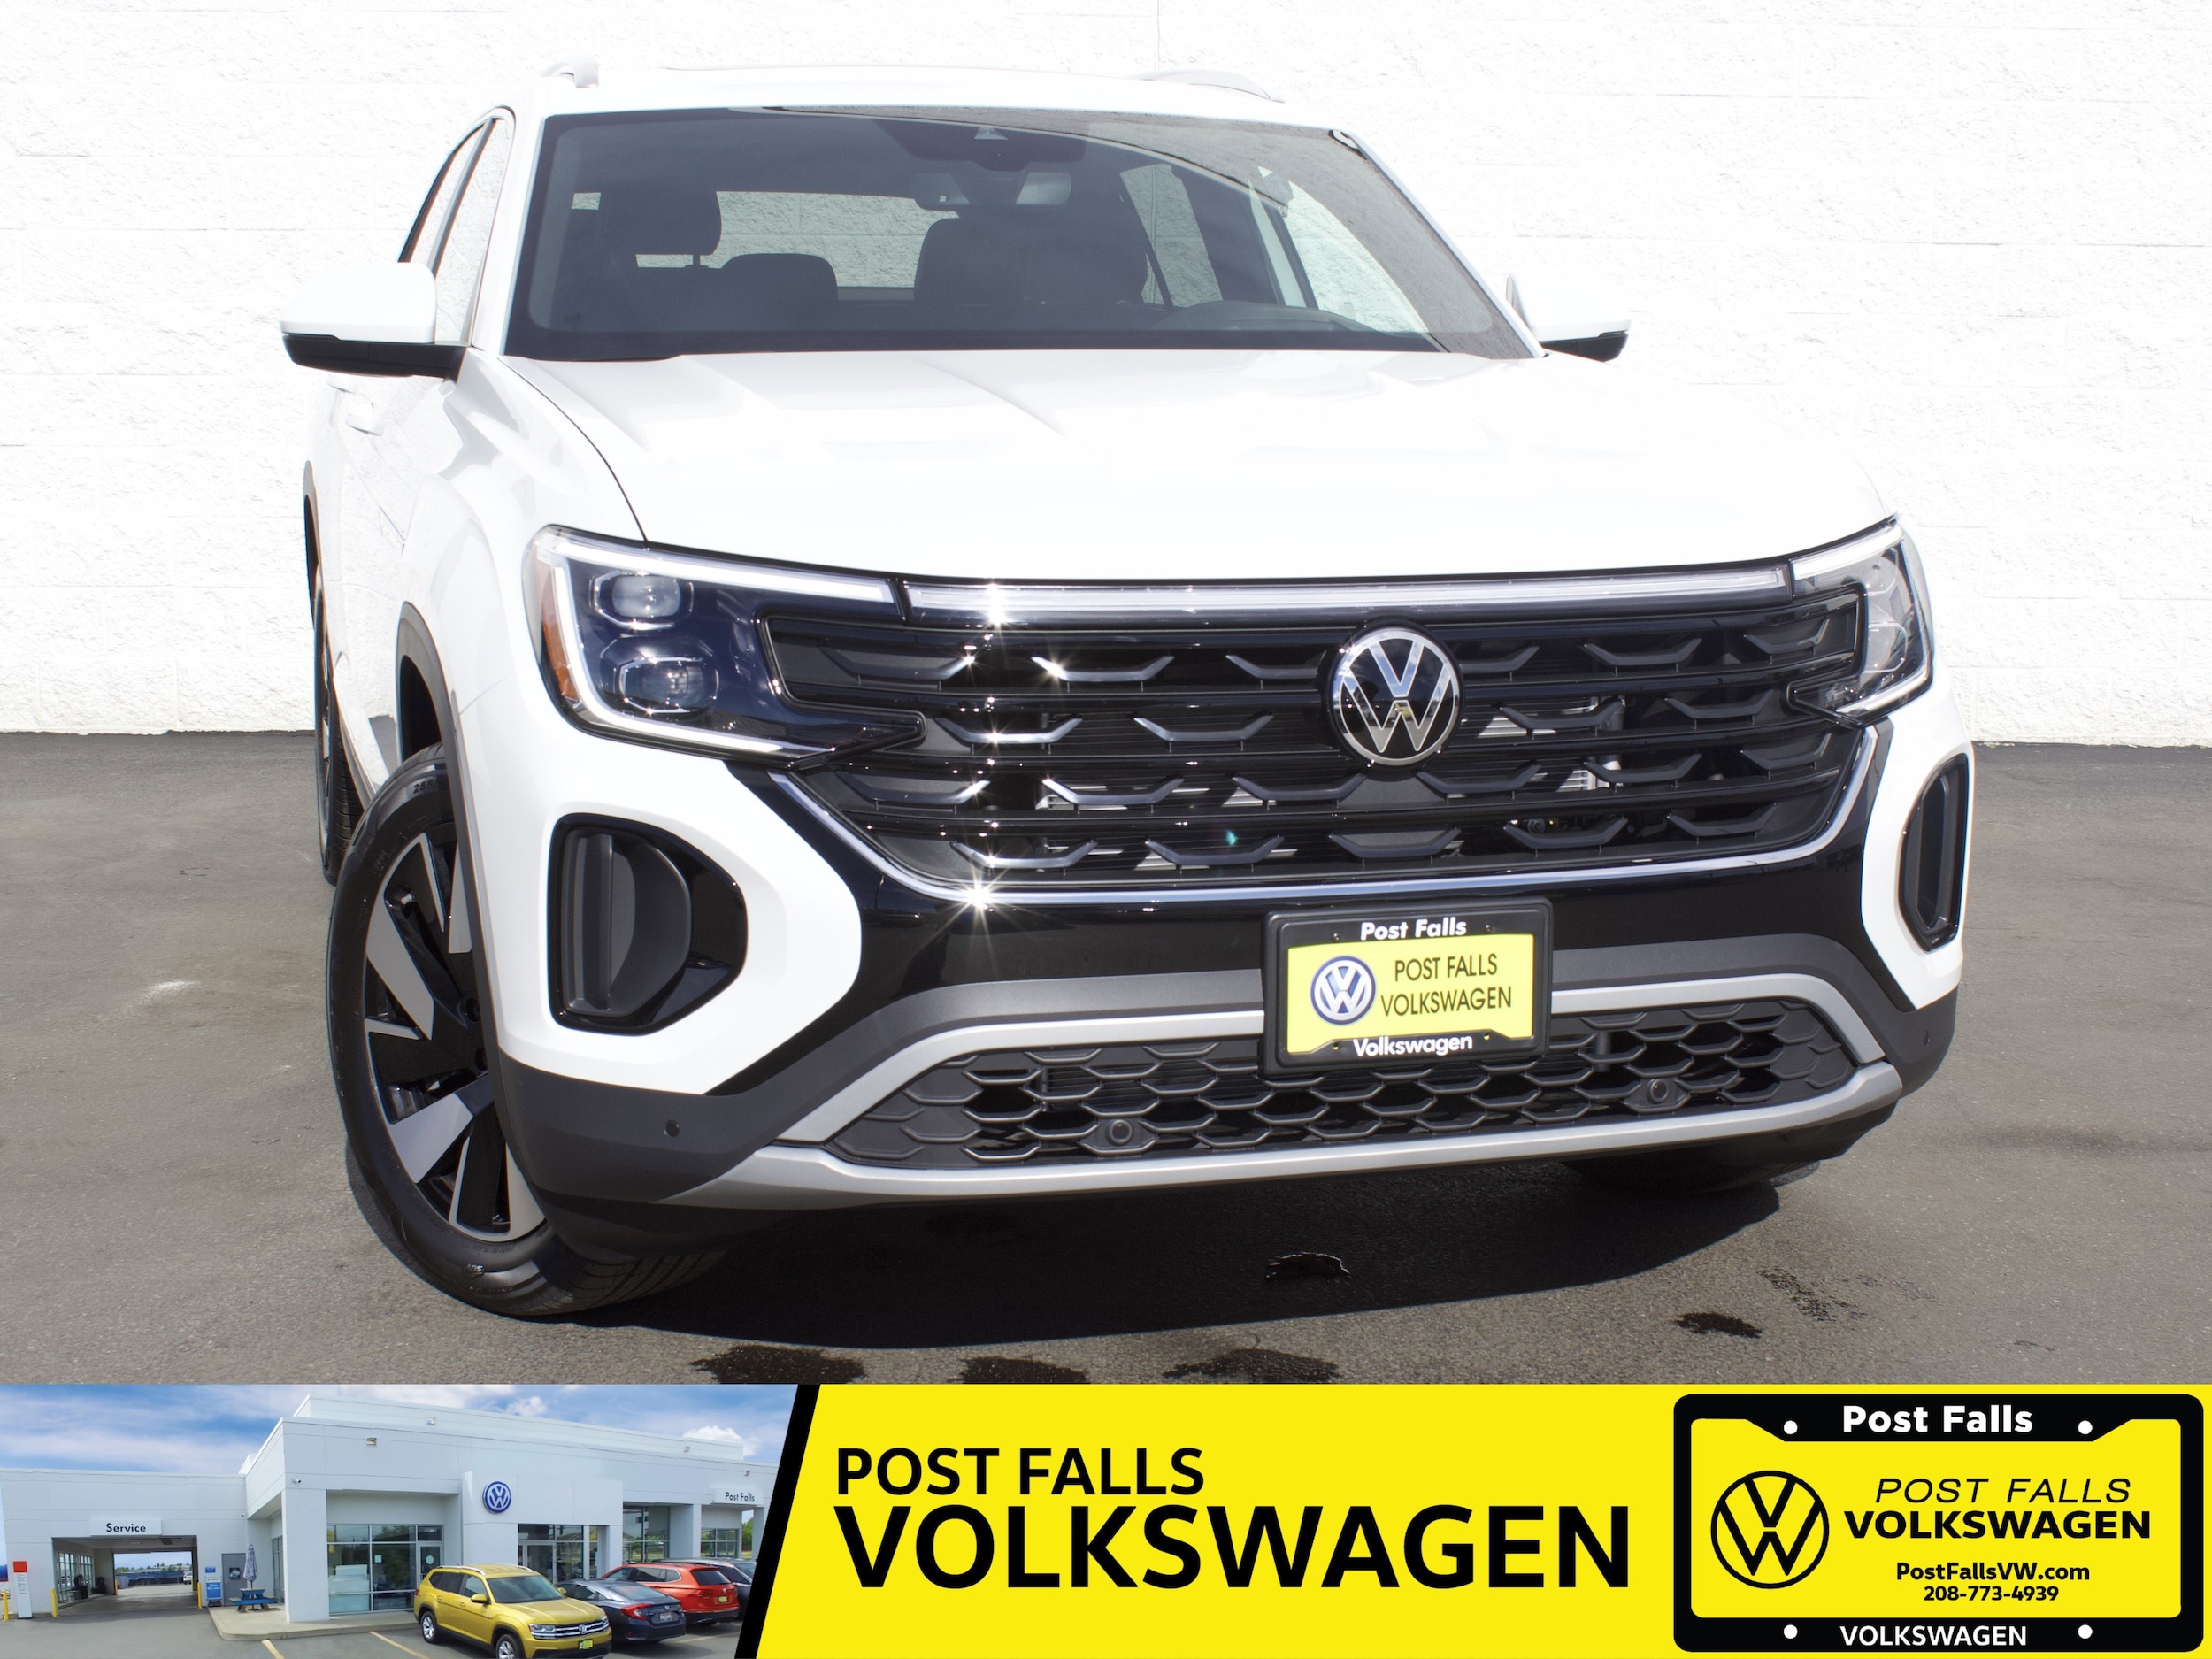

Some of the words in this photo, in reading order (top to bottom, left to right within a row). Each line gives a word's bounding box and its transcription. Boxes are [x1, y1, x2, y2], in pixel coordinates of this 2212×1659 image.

[1360, 921, 1409, 941] Post
[1415, 916, 1467, 938] Falls
[1394, 957, 1441, 982] POST
[1447, 953, 1498, 978] FALLS
[1380, 987, 1512, 1017] VOLKSWAGEN
[1353, 1035, 1473, 1057] Volkswagen
[725, 1492, 739, 1501] Post
[740, 1493, 755, 1502] Falls
[105, 1523, 147, 1532] Service
